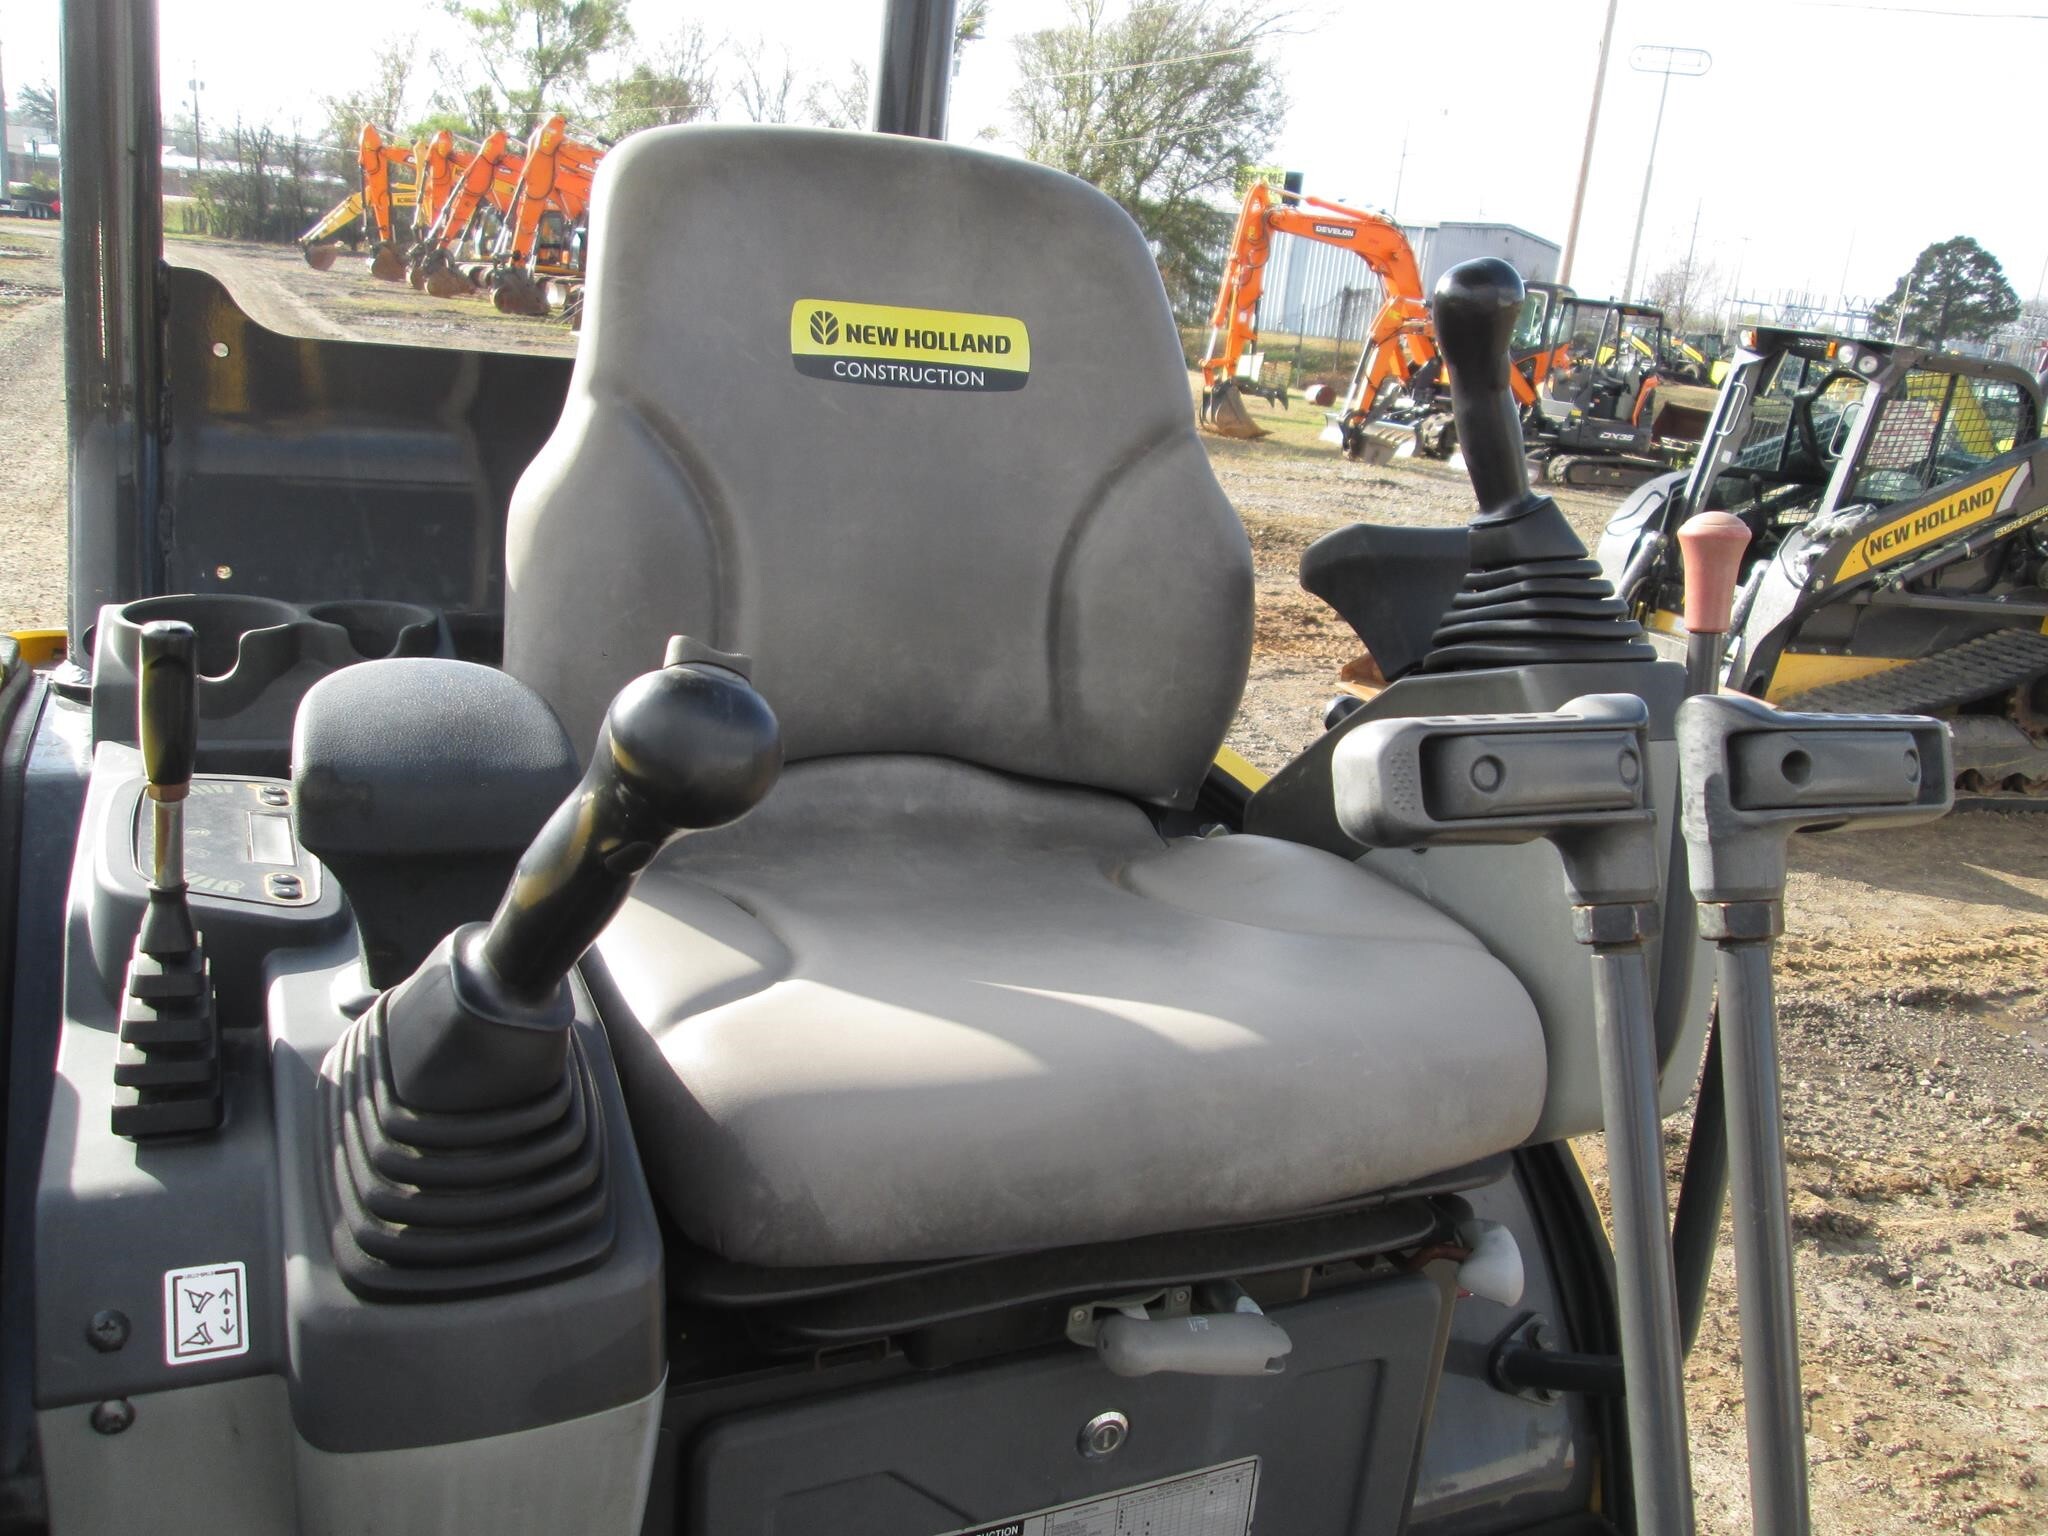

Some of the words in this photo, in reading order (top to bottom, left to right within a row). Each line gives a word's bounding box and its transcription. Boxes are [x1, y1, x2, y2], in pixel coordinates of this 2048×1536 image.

[1315, 225, 1354, 237] DEVELON
[846, 323, 899, 347] NEW
[904, 328, 1012, 355] HOLLAND
[833, 360, 985, 387] CONSTRUCTION
[1869, 523, 1911, 556] NEW
[1914, 487, 1995, 536] HOLLAND
